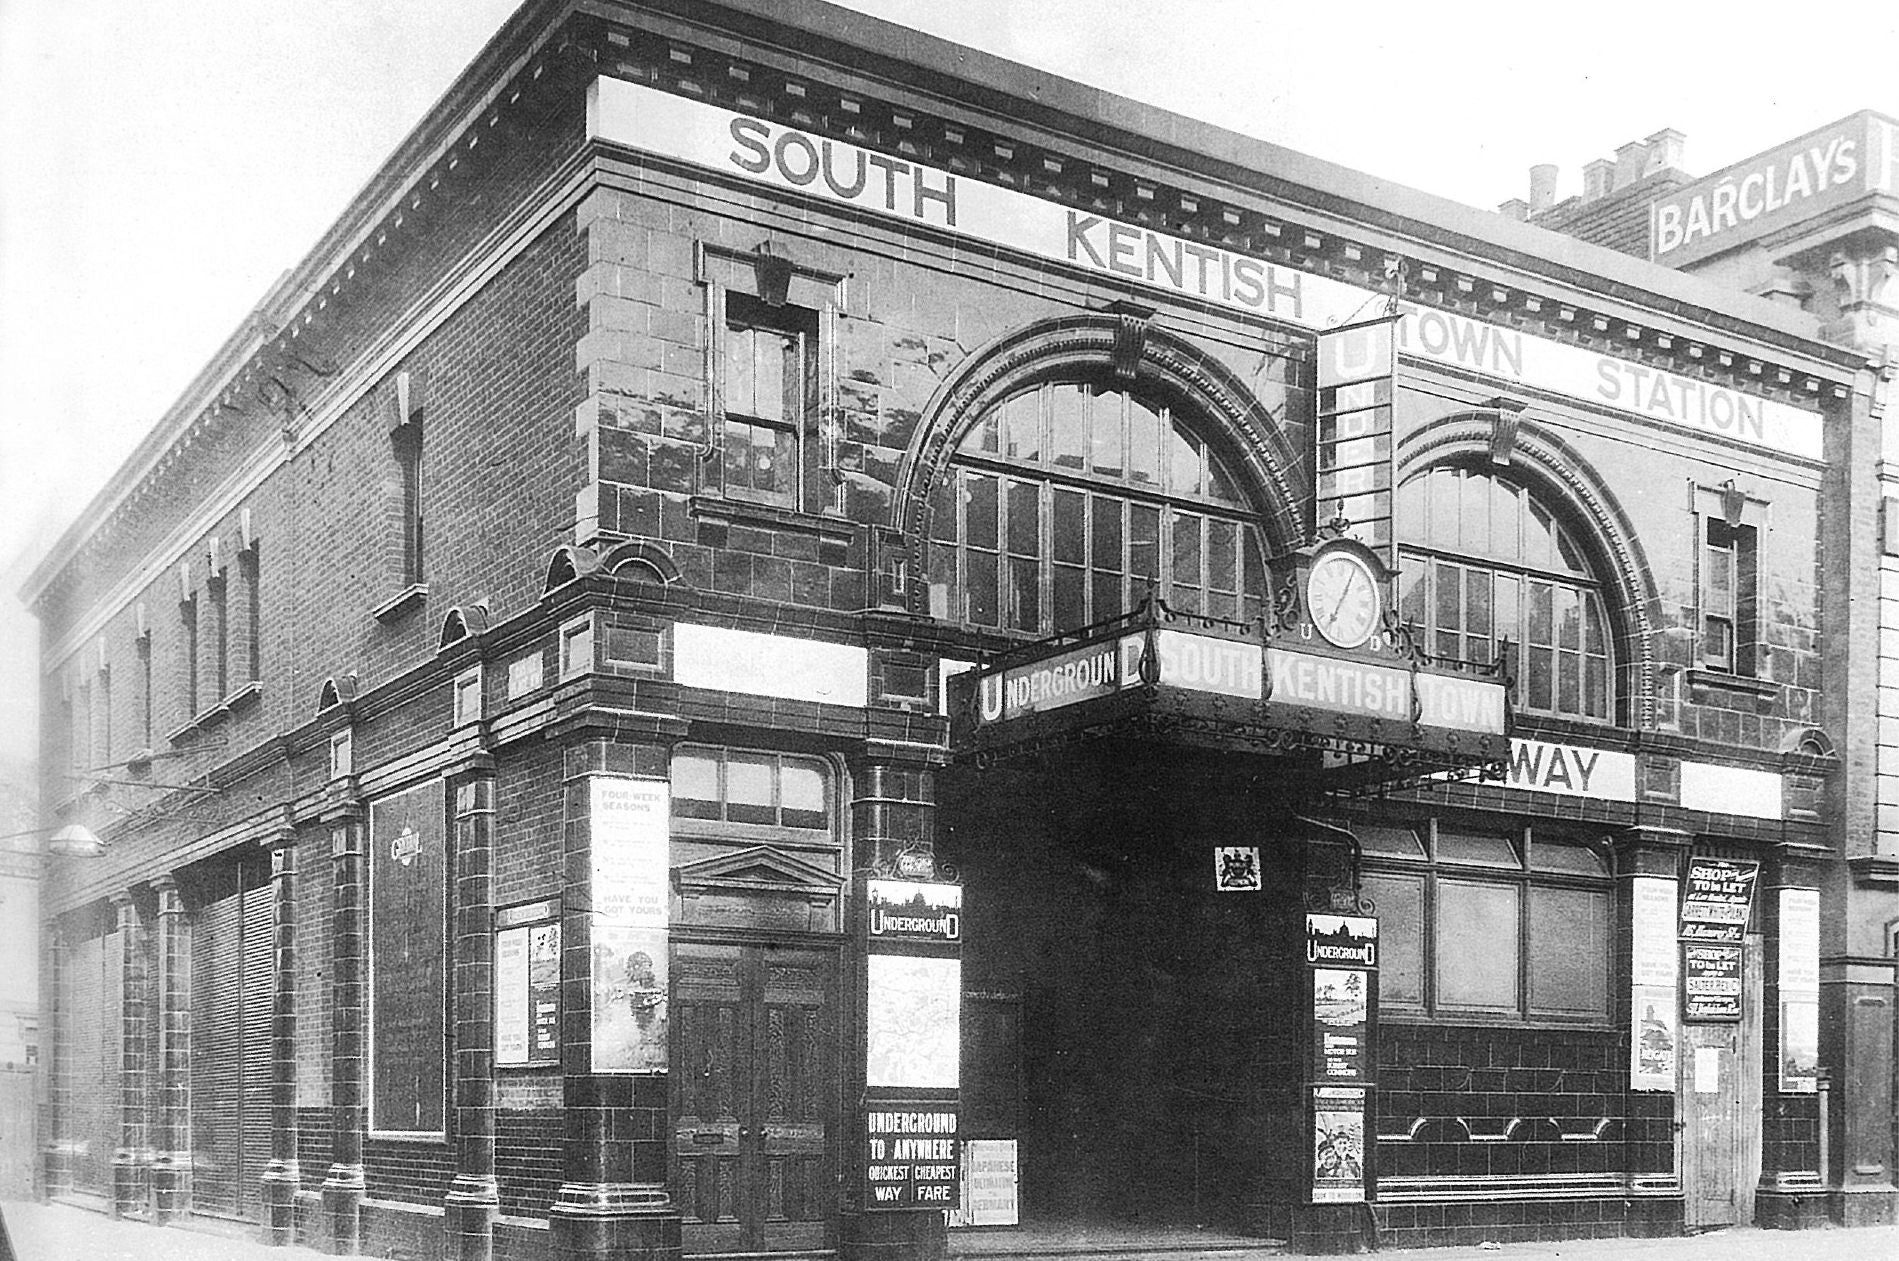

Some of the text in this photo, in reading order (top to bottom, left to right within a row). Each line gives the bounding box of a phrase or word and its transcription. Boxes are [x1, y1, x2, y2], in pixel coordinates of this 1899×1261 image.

[730, 116, 1764, 440] SOUTH KENTISH TOWN STATION
[976, 636, 1147, 721] UNDERGROUND
[1160, 640, 1498, 730] SOUTH KENTISH TOWN
[1508, 743, 1600, 792] WAY
[602, 801, 651, 812] SEASONS
[1689, 865, 1731, 881] SHOP
[1692, 880, 1710, 891] TO
[1722, 881, 1746, 893] LET
[603, 894, 659, 905] HAVE YOU
[604, 905, 625, 915] GOT
[871, 908, 959, 939] UNDERGROUND
[1307, 939, 1374, 965] UNDERGROUND
[1689, 959, 1705, 970] TO
[1716, 960, 1737, 971] LET
[868, 1112, 957, 1134] UNDERGROUND
[869, 1138, 885, 1160] TO
[893, 1138, 954, 1160] ANYWHERE
[868, 1165, 956, 1181] QUICKEST CHEAPEST
[875, 1185, 951, 1201] WAY FARE
